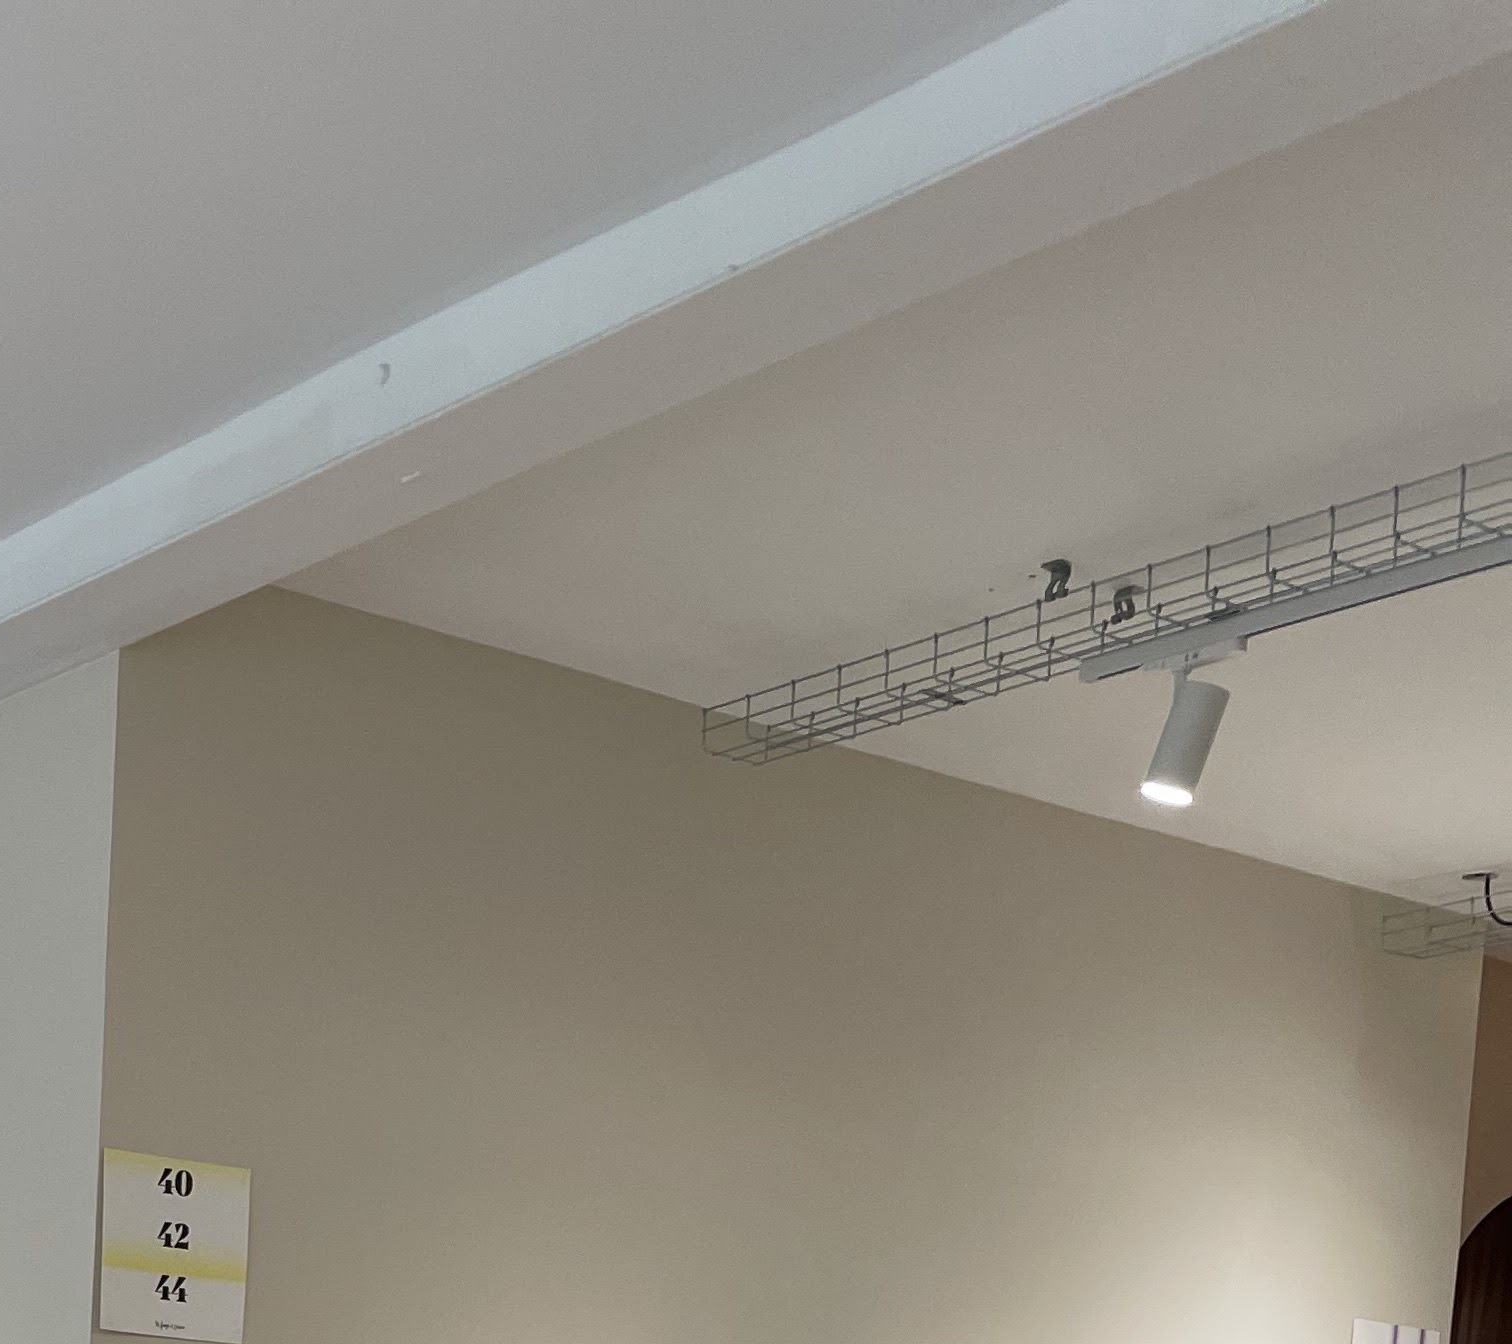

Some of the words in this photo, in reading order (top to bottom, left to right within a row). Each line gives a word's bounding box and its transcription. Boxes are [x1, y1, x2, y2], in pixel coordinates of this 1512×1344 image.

[158, 1168, 193, 1197] 40
[158, 1222, 189, 1250] 42
[155, 1275, 188, 1302] 44
